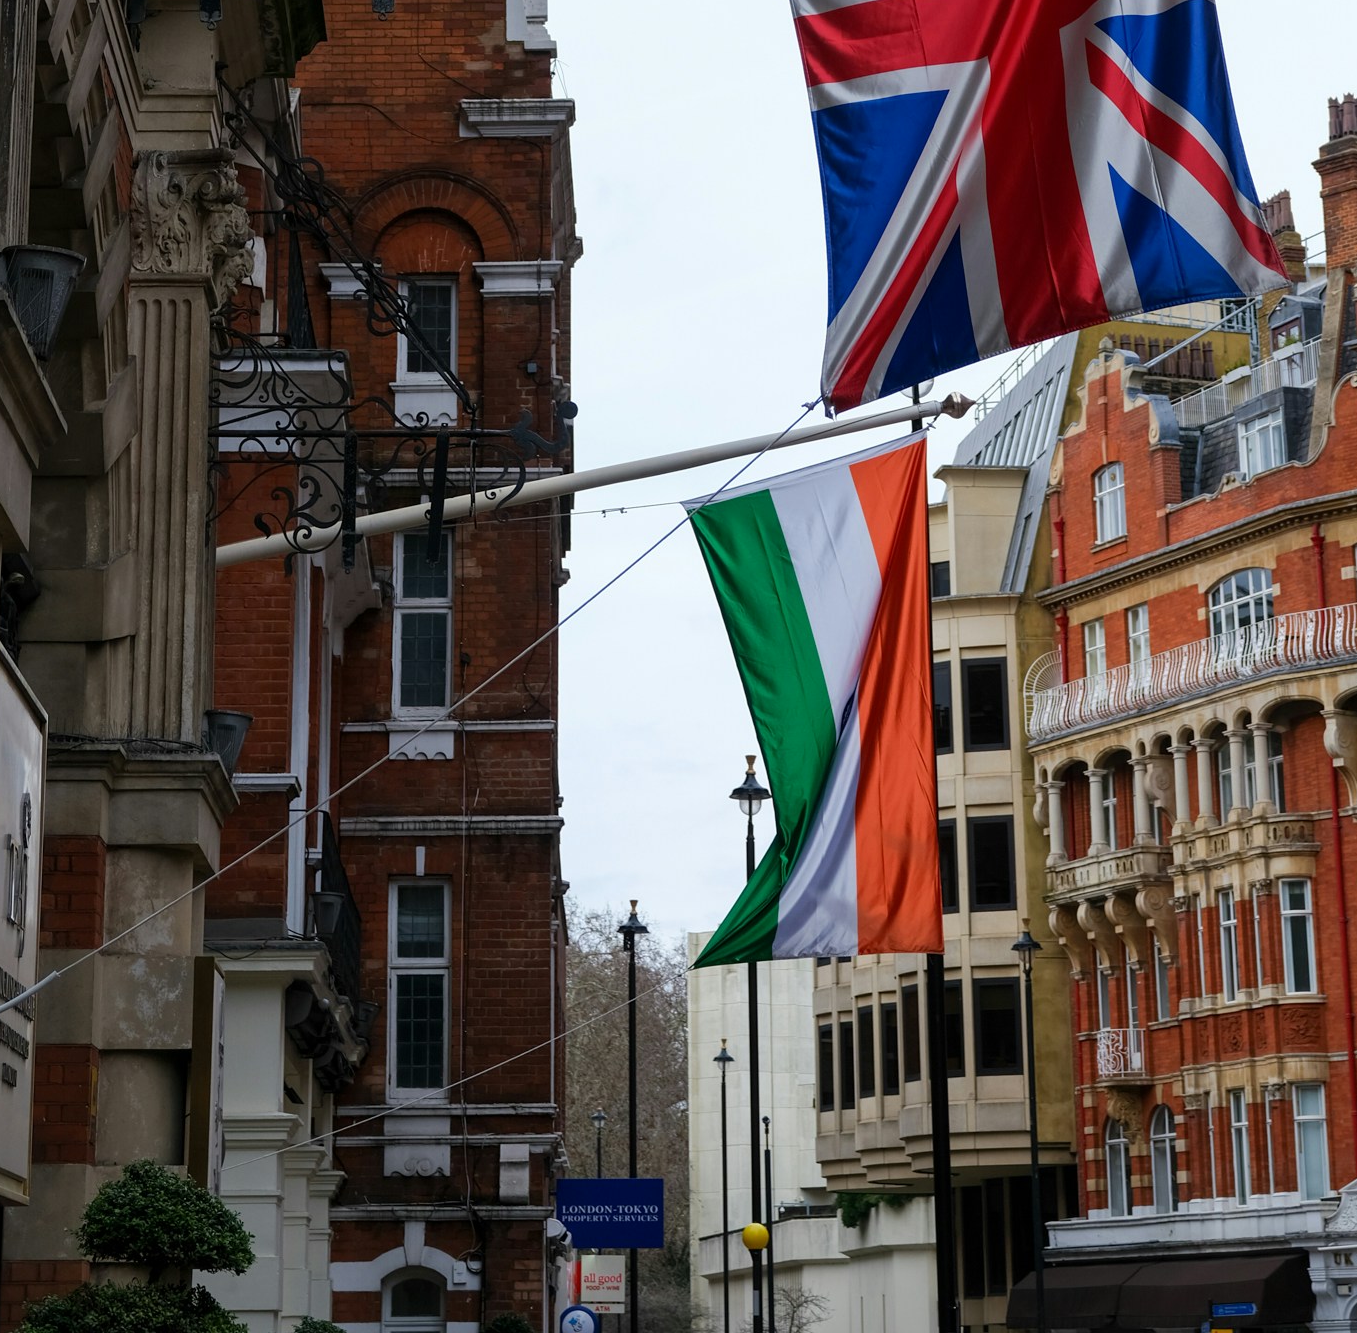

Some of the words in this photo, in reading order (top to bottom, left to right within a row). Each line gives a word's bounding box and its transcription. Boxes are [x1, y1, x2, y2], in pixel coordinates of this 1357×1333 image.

[562, 1205, 659, 1214] LONDON-TOKYO
[562, 1214, 610, 1222] PROPERTY
[612, 1214, 659, 1222] SERVICES
[1333, 1252, 1353, 1265] UK
[584, 1273, 596, 1283] all
[598, 1273, 622, 1285] good
